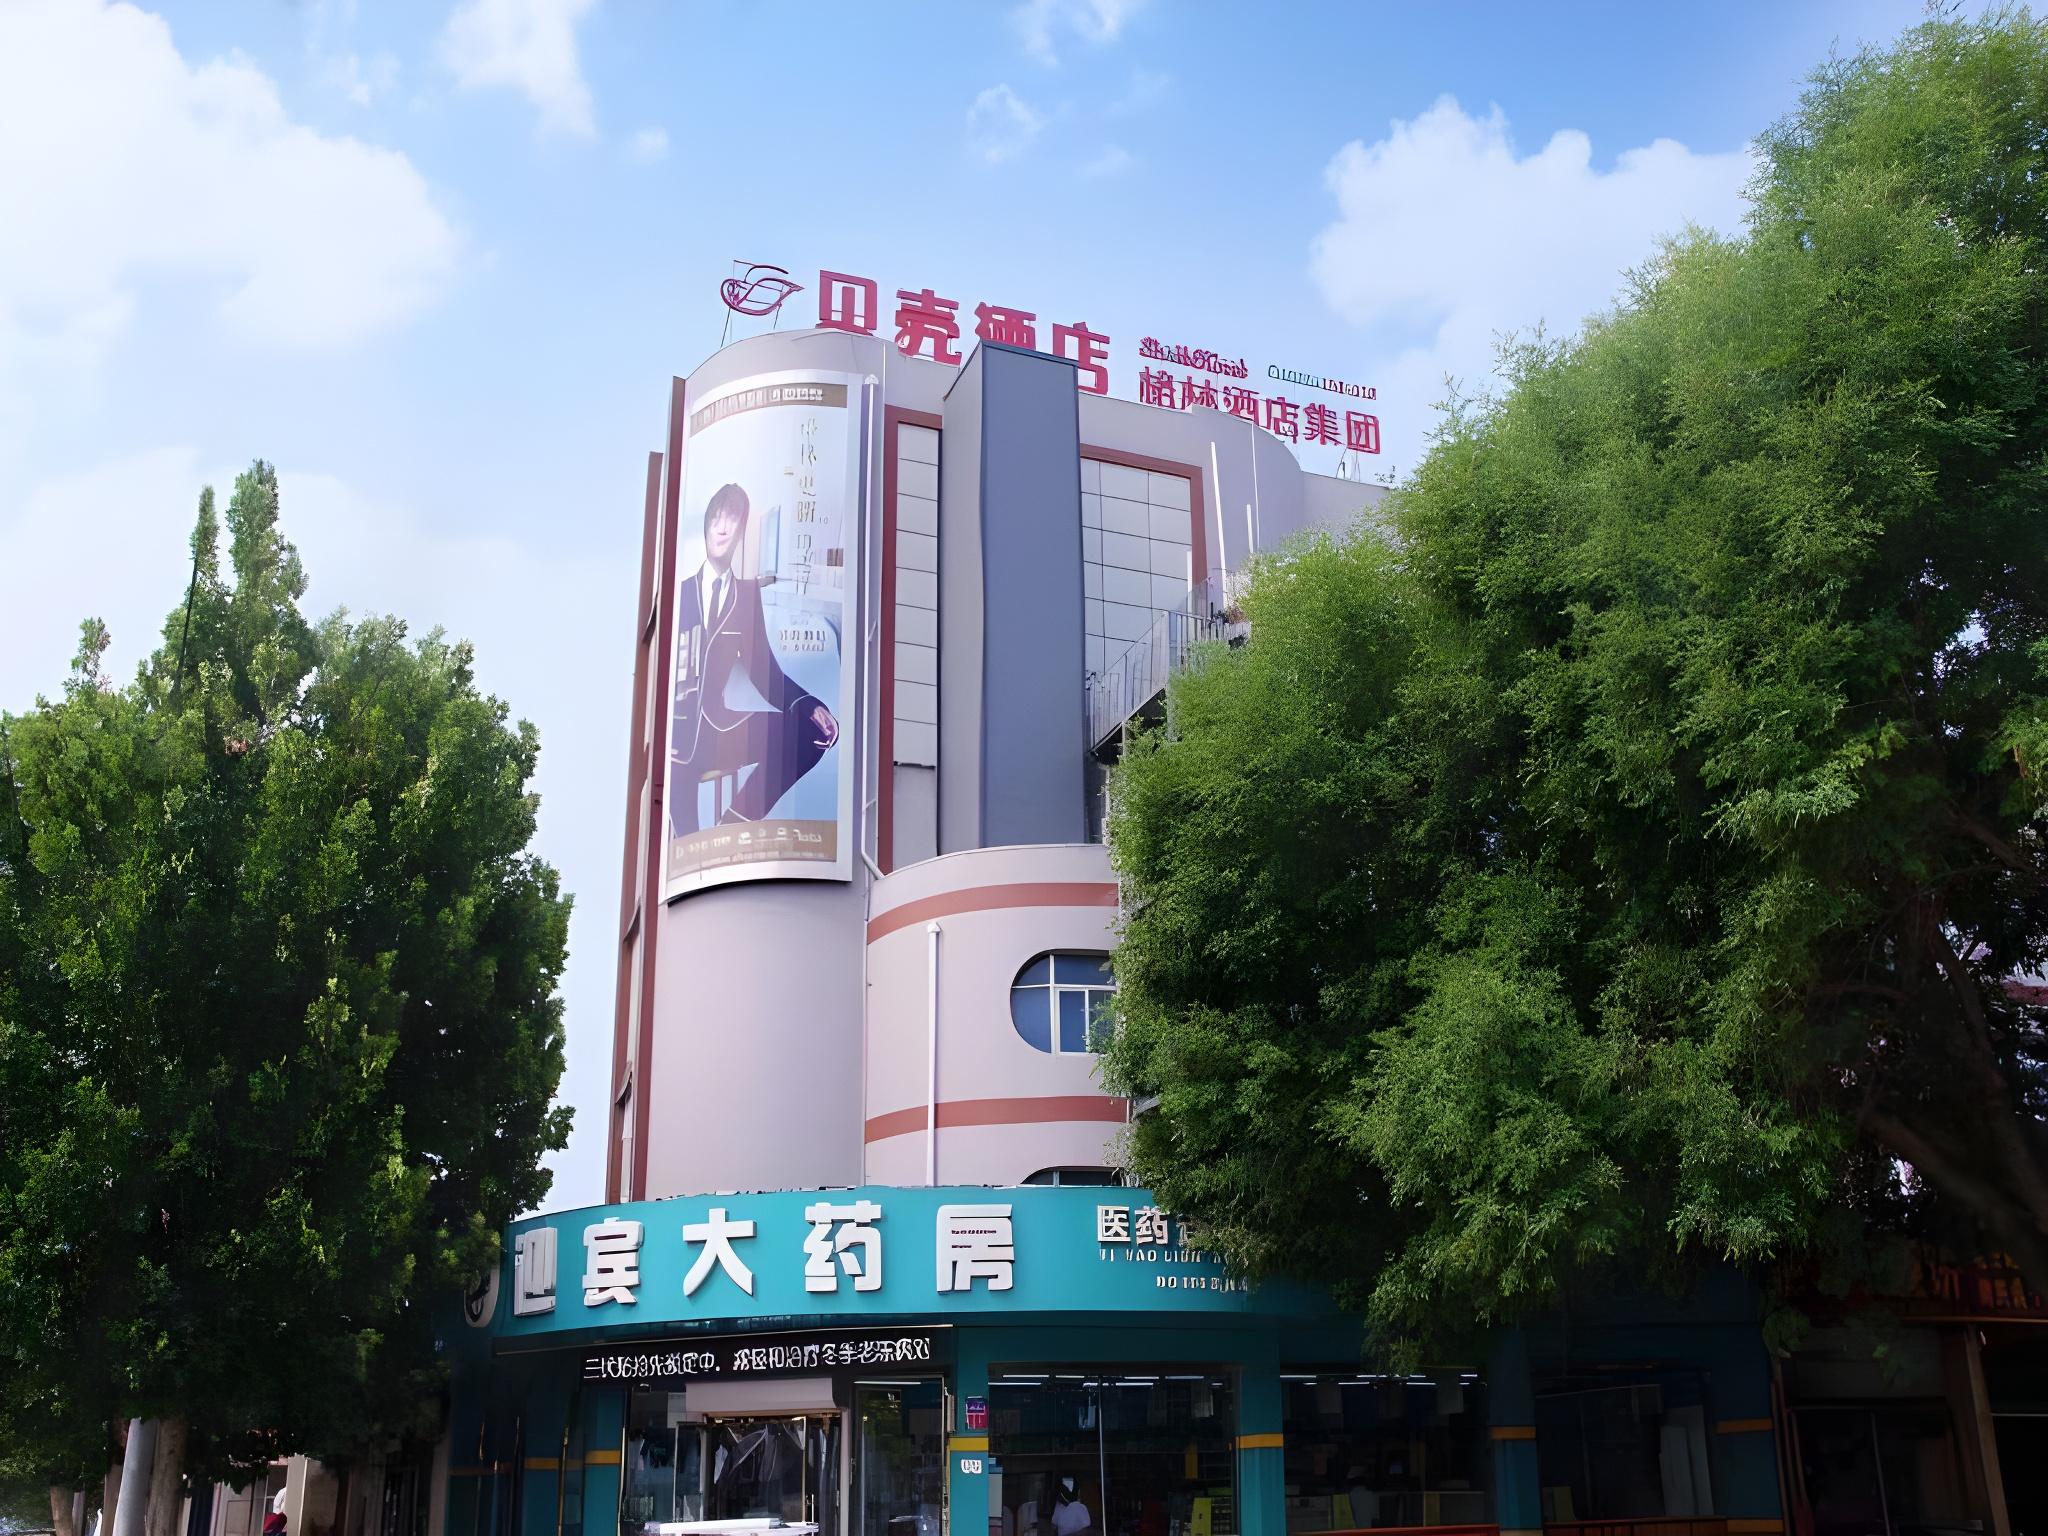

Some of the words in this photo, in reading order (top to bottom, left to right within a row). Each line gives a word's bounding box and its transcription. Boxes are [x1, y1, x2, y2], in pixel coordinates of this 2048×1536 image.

[815, 269, 1111, 396] 贝壳酒店
[1138, 365, 1382, 454] 格林酒店集团
[512, 1199, 1015, 1317] 迎宾大药房
[1097, 1205, 1195, 1248] 医药
